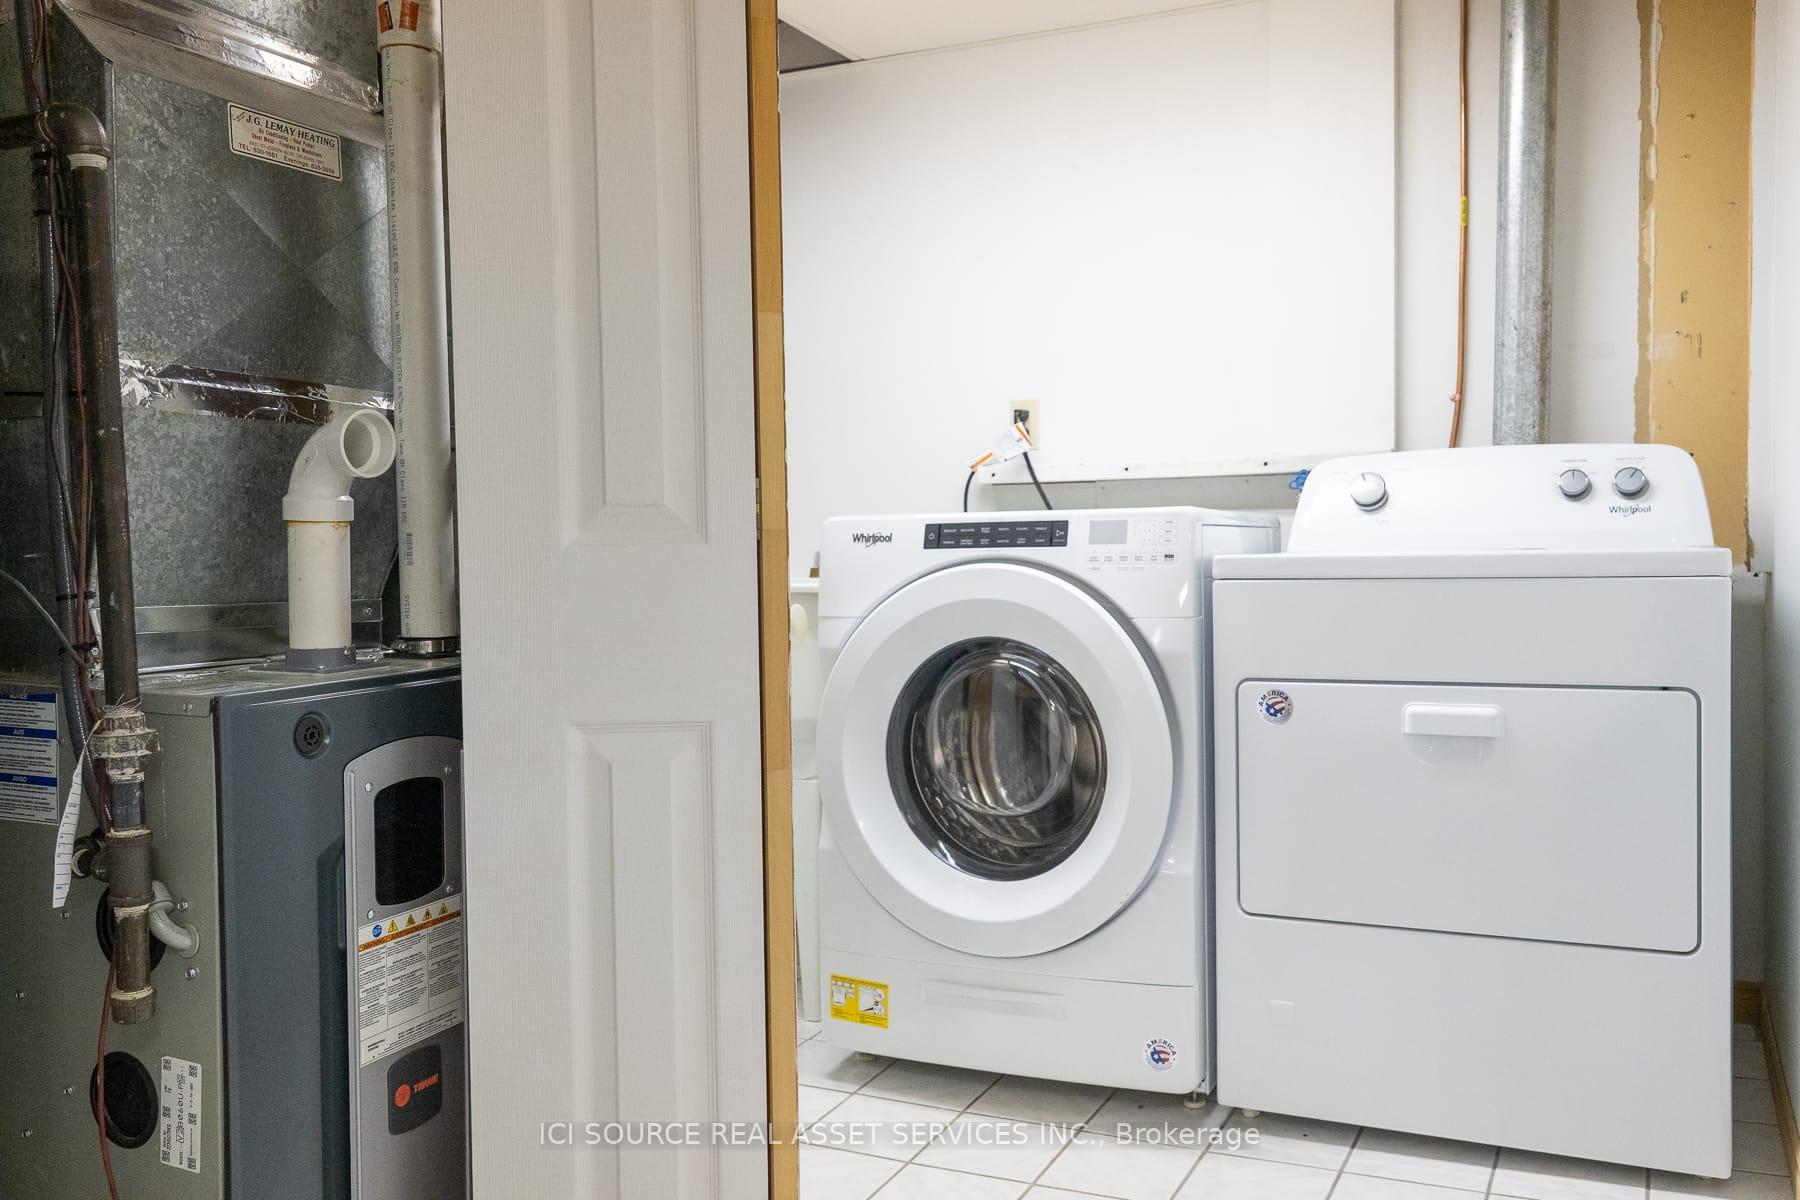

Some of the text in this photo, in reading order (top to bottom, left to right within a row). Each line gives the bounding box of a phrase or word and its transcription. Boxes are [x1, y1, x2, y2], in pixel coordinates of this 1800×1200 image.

[246, 115, 334, 148] J.G. LEMAY HEATING
[239, 142, 250, 150] TEL:
[1608, 505, 1652, 517] Whirlpool
[851, 532, 893, 547] Whirlpool
[1258, 690, 1289, 707] AMERICA
[1146, 1039, 1177, 1056] AMERICA
